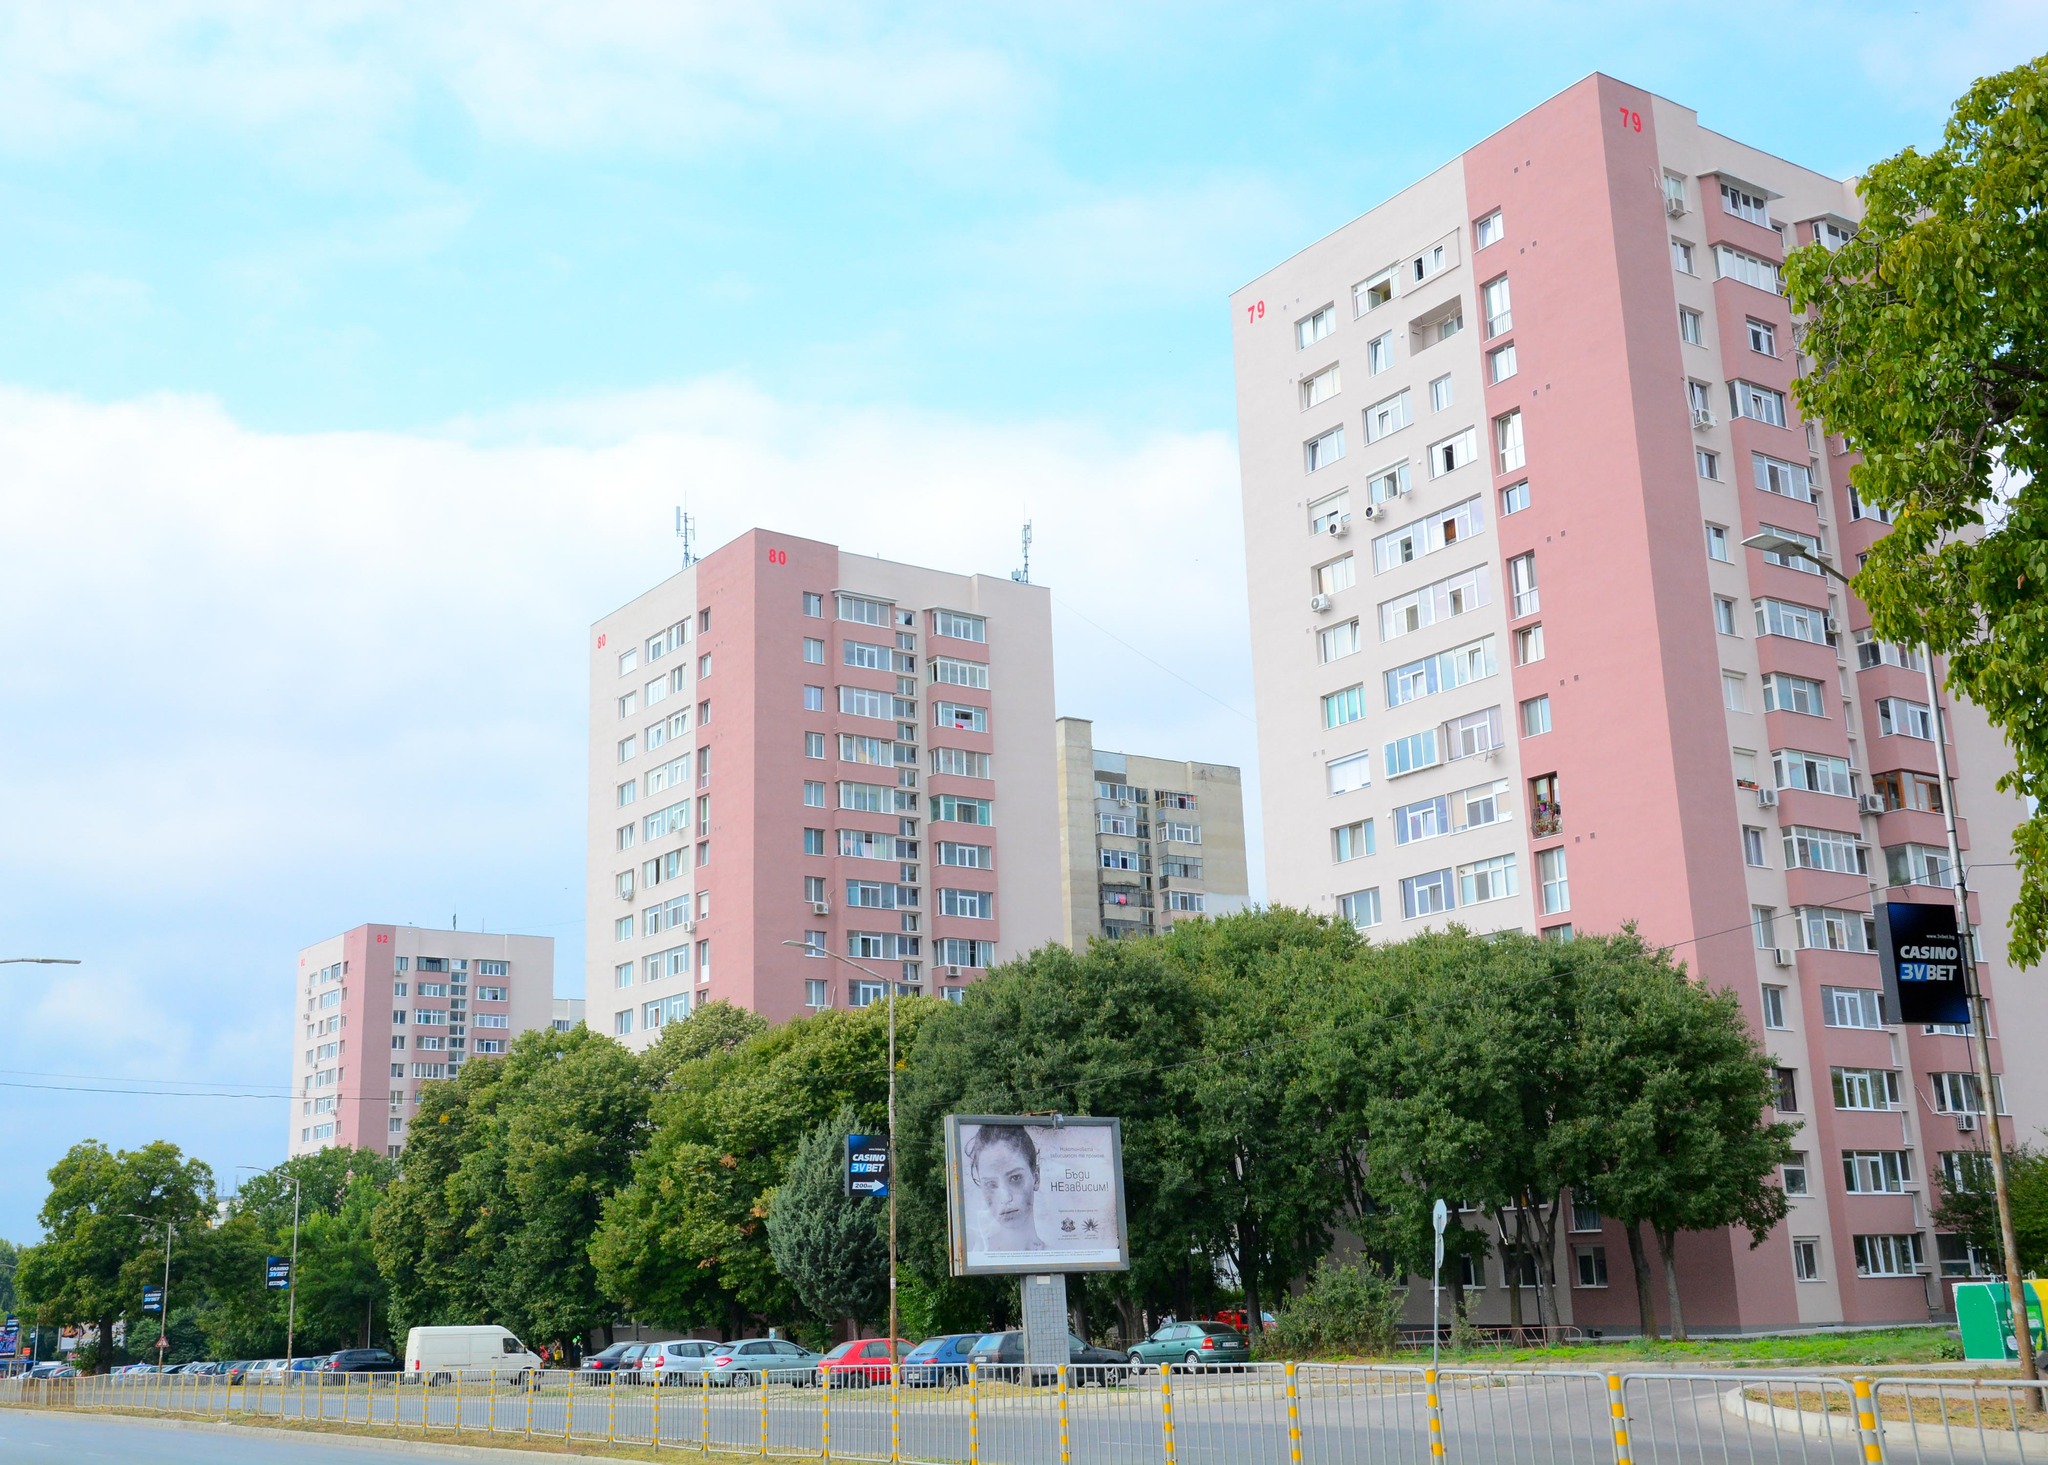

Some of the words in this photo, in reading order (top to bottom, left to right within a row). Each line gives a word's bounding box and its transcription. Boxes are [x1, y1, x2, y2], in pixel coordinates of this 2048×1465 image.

[1619, 106, 1642, 133] 79
[1247, 300, 1265, 324] 79
[769, 548, 787, 565] 80
[597, 633, 606, 649] 80
[376, 934, 389, 943] 82
[1900, 945, 1958, 960] CASINO
[1901, 963, 1957, 981] 3VBET
[852, 1153, 886, 1162] CASINO
[851, 1163, 885, 1173] 3VBET
[1065, 1168, 1090, 1182] Бъди
[1050, 1181, 1109, 1192] НЕзависим!
